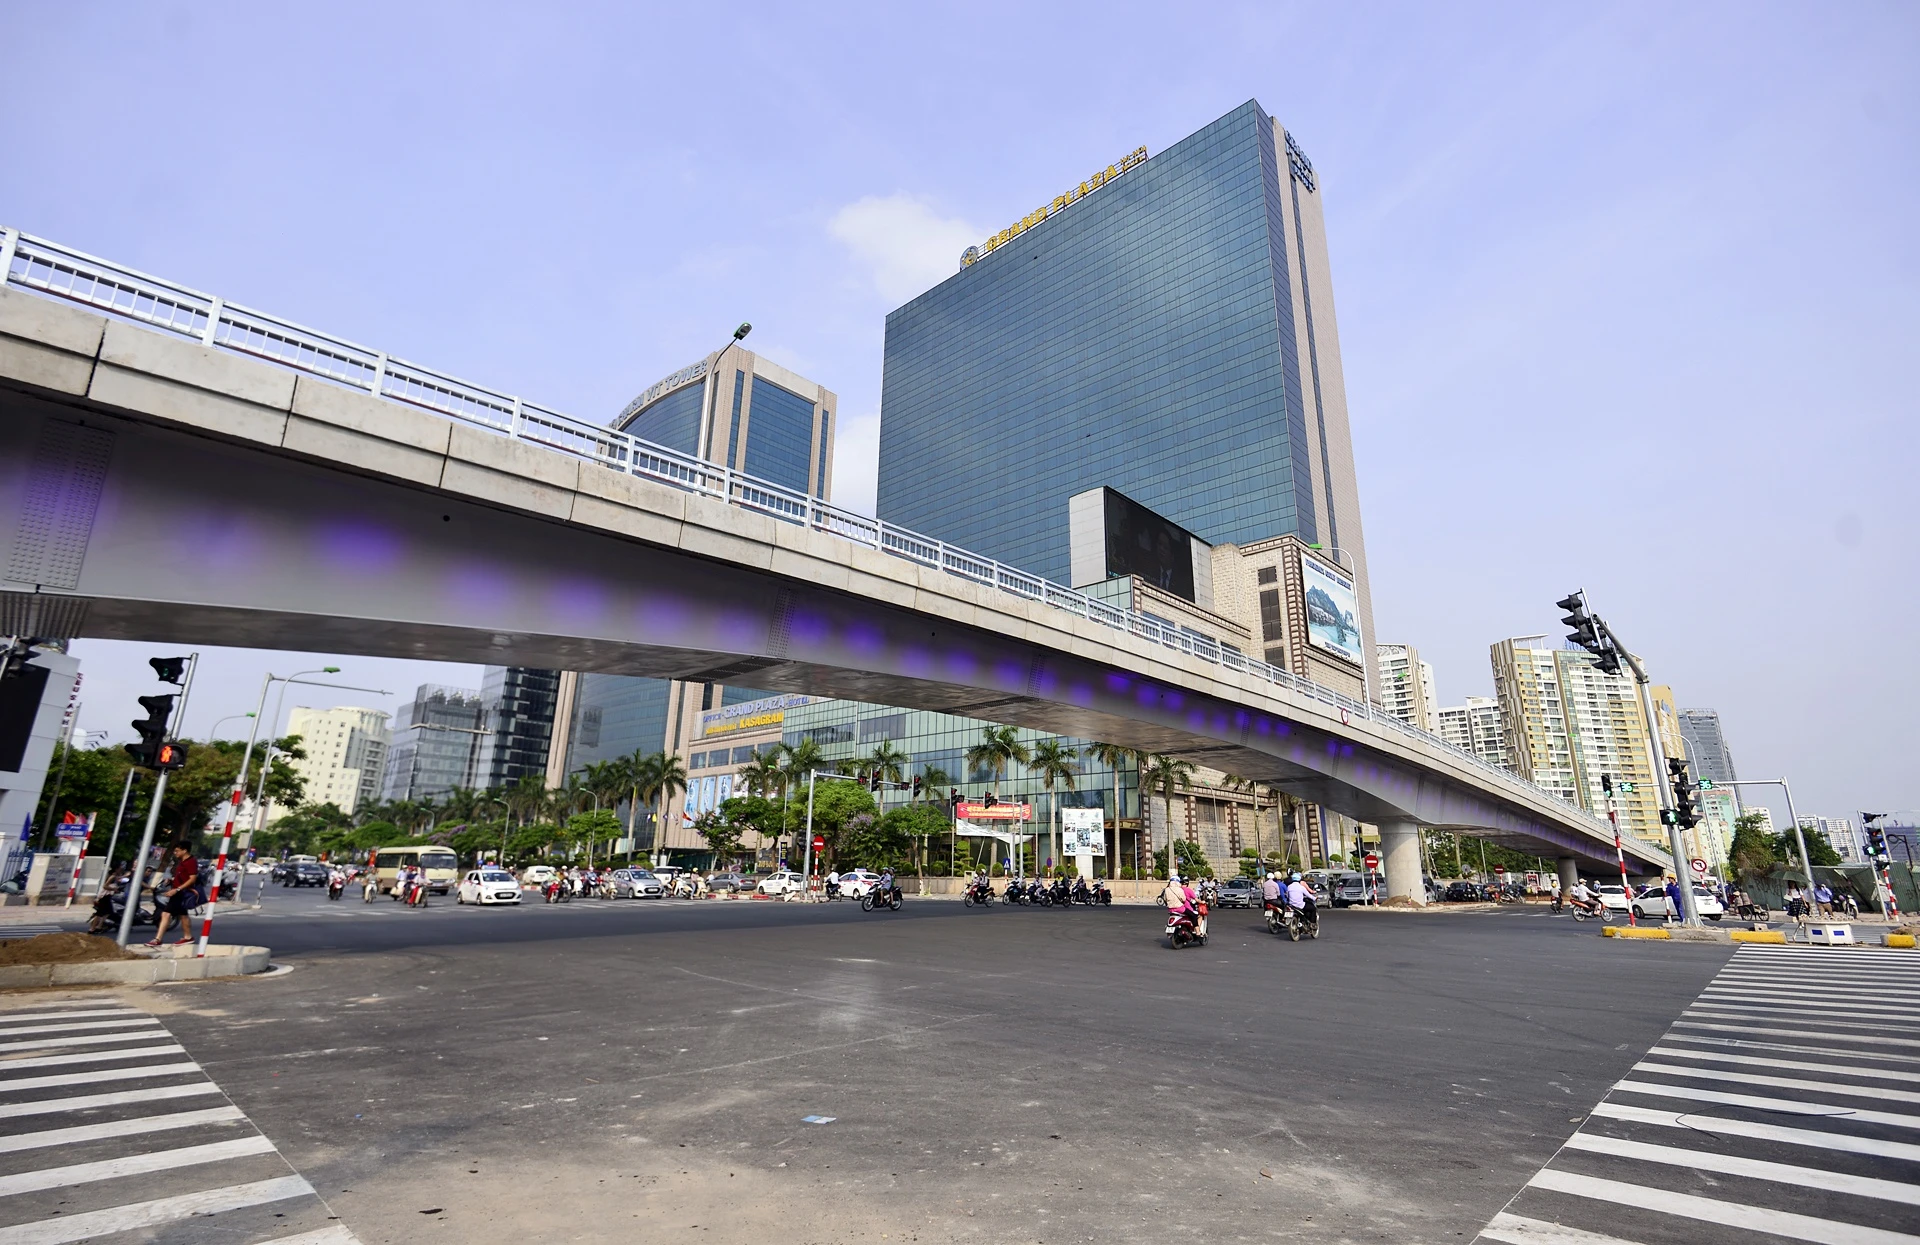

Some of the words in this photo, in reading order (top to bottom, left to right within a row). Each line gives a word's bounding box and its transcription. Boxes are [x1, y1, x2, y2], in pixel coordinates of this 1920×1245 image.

[986, 207, 1048, 251] GRAND
[1052, 165, 1118, 212] PLAZA
[665, 359, 708, 391] TOWER
[724, 703, 754, 719] GRAND
[755, 697, 785, 713] PLAZA
[1621, 783, 1632, 792] 36
[1700, 780, 1711, 789] 36
